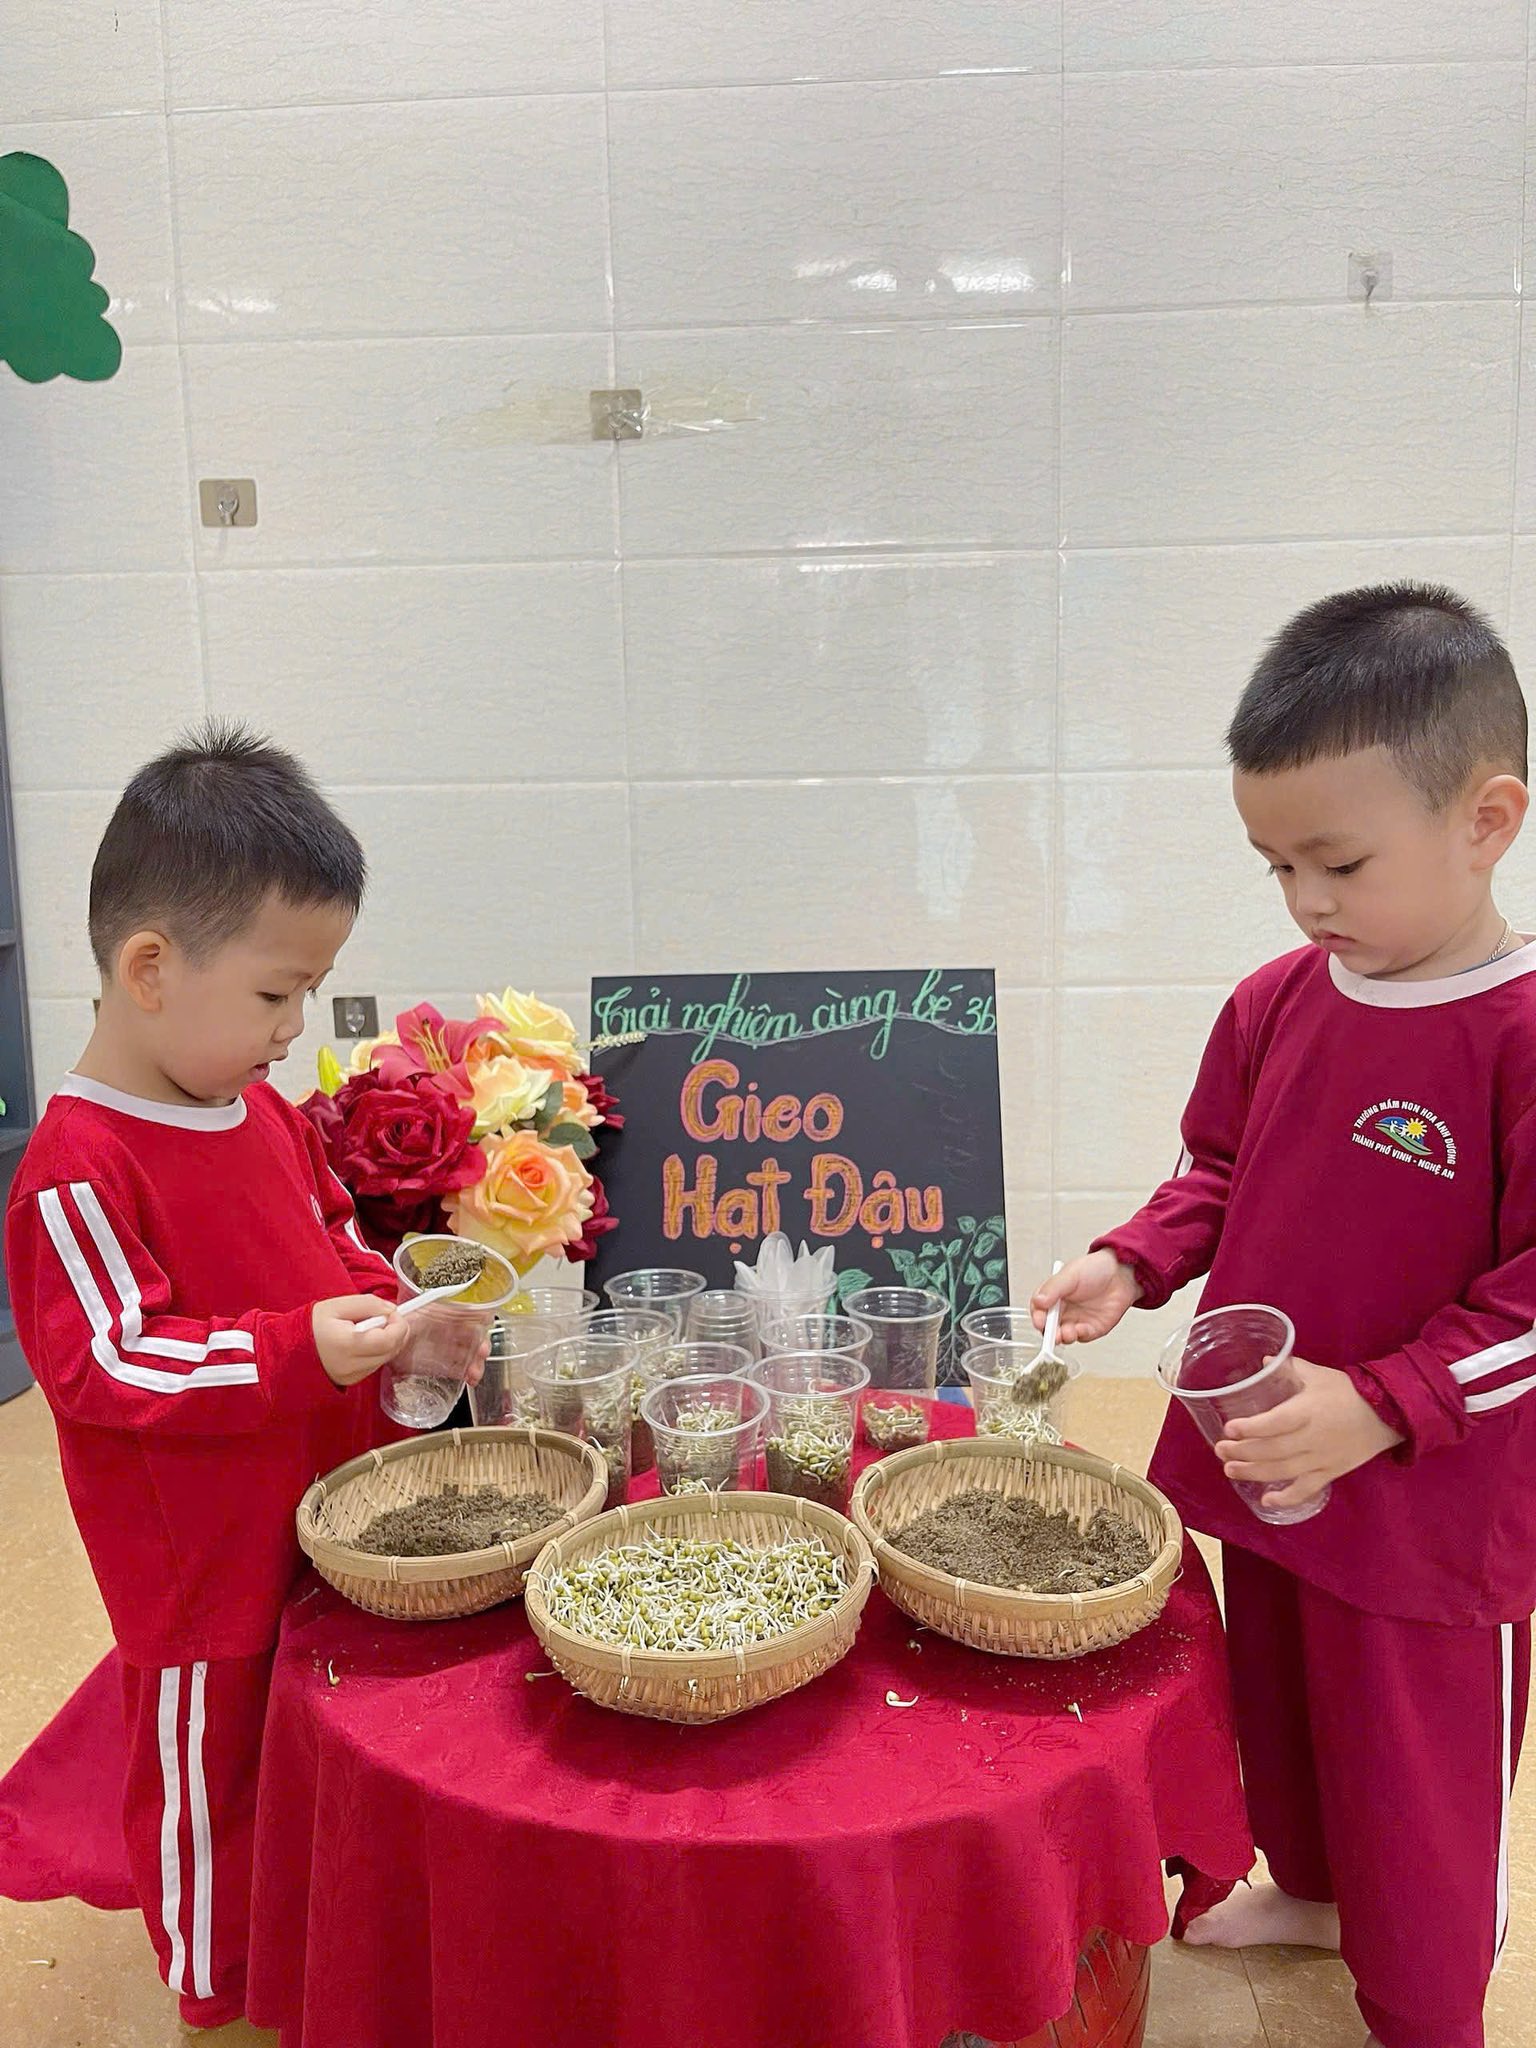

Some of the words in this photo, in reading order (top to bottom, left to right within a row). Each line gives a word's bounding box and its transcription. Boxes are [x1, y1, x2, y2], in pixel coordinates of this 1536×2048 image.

[594, 986, 671, 1036] Trải
[682, 973, 804, 1064] nghiệm
[812, 987, 898, 1060] cùng
[912, 968, 964, 1024] bé
[681, 1059, 845, 1143] Gieo
[1353, 1104, 1379, 1129] TRƯỜNG
[1401, 1101, 1420, 1113] NON
[1421, 1108, 1438, 1123] HOA
[1434, 1121, 1451, 1138] ÁNH
[1352, 1132, 1375, 1149] THÀNH
[1375, 1142, 1392, 1155] PHỐ
[1392, 1150, 1412, 1163] VINH
[1417, 1158, 1442, 1175] NGHỆ
[1441, 1169, 1455, 1180] AN
[662, 1153, 792, 1254] Hạt
[803, 1153, 944, 1249] Đậu
